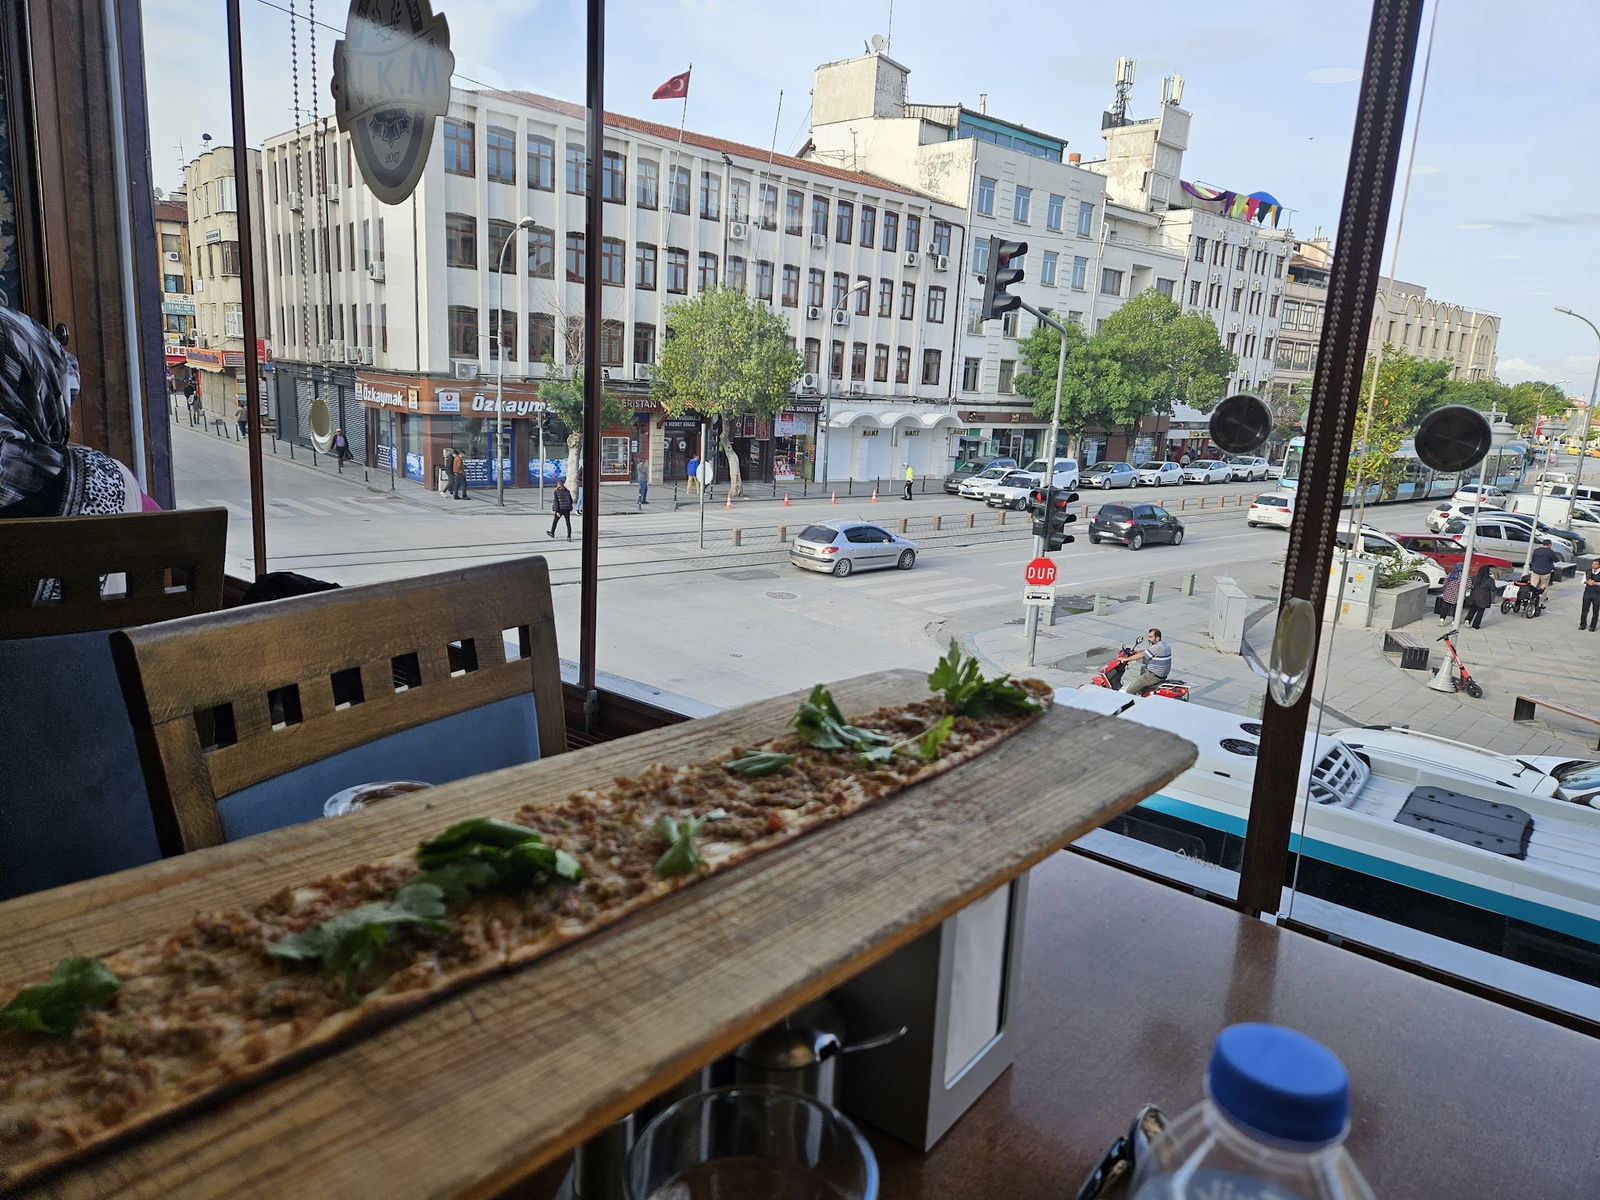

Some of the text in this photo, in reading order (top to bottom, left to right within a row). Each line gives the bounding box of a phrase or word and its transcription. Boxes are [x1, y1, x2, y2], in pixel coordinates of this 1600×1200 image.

[363, 384, 403, 407] Özkaymak
[471, 393, 555, 416] Özkayma
[1027, 567, 1055, 580] DUR
